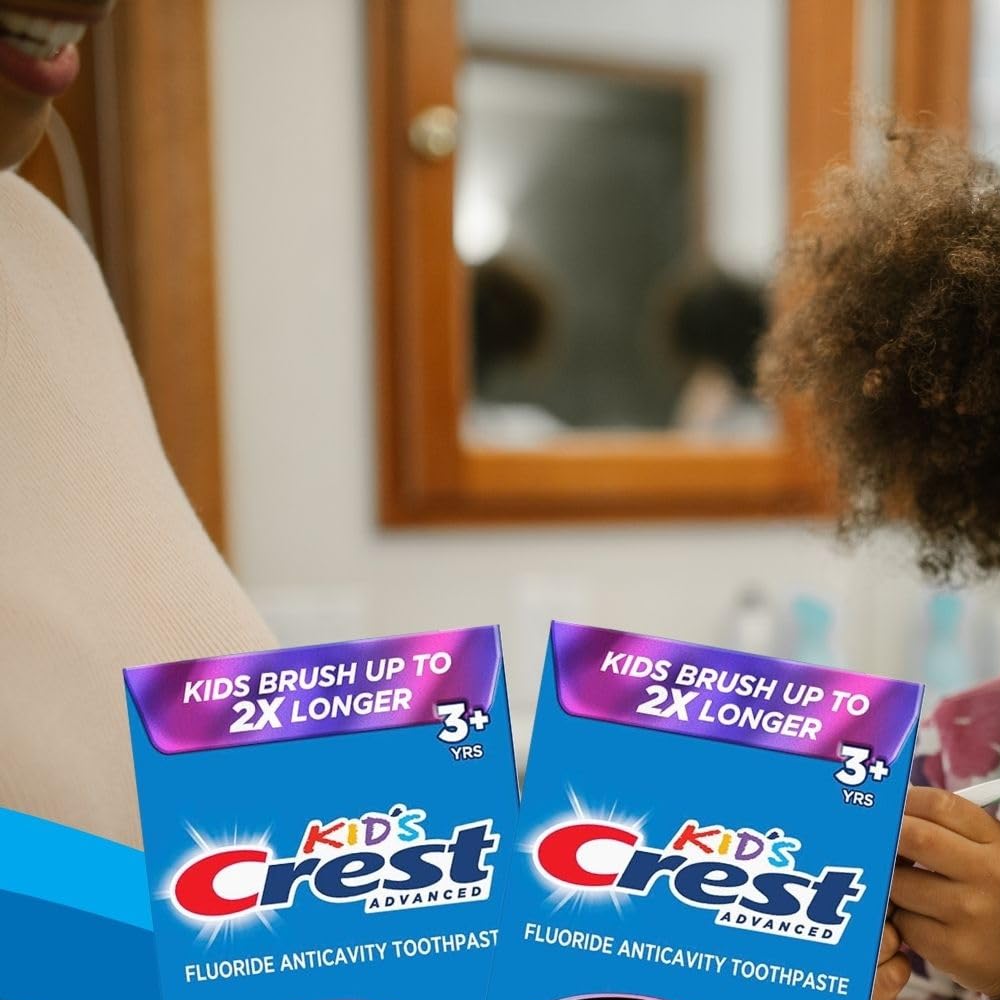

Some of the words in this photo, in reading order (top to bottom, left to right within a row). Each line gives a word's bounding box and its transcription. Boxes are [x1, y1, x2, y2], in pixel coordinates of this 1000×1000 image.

[183, 675, 250, 703] KIDS
[258, 663, 357, 694] BRUSH
[366, 658, 405, 681] UP
[412, 652, 452, 677] TO
[600, 651, 672, 682] KIDS
[675, 664, 778, 700] BRUSH
[783, 683, 824, 707] UP
[831, 691, 870, 716] TO
[229, 698, 283, 733] 2X
[291, 688, 412, 723] LONGER
[437, 704, 489, 742] 3+
[637, 685, 700, 721] 2X
[698, 700, 822, 740] LONGER
[451, 745, 483, 760] YRS
[835, 746, 889, 785] 3+
[842, 790, 874, 807] YRS
[303, 807, 422, 855] KID'S
[673, 824, 797, 868] KID'S
[175, 824, 495, 916] Crest
[537, 824, 860, 925] Crest
[369, 886, 482, 909] ADVANCED
[720, 911, 833, 939] ADVANCED
[185, 956, 275, 983] FLUORIDE
[280, 943, 388, 972] ANTICAVITY
[391, 929, 499, 958] TOOTHPAST
[524, 923, 613, 954] FLUORIDE
[617, 939, 728, 973] ANTICAVITY
[731, 958, 850, 994] TOOTHPASTE
